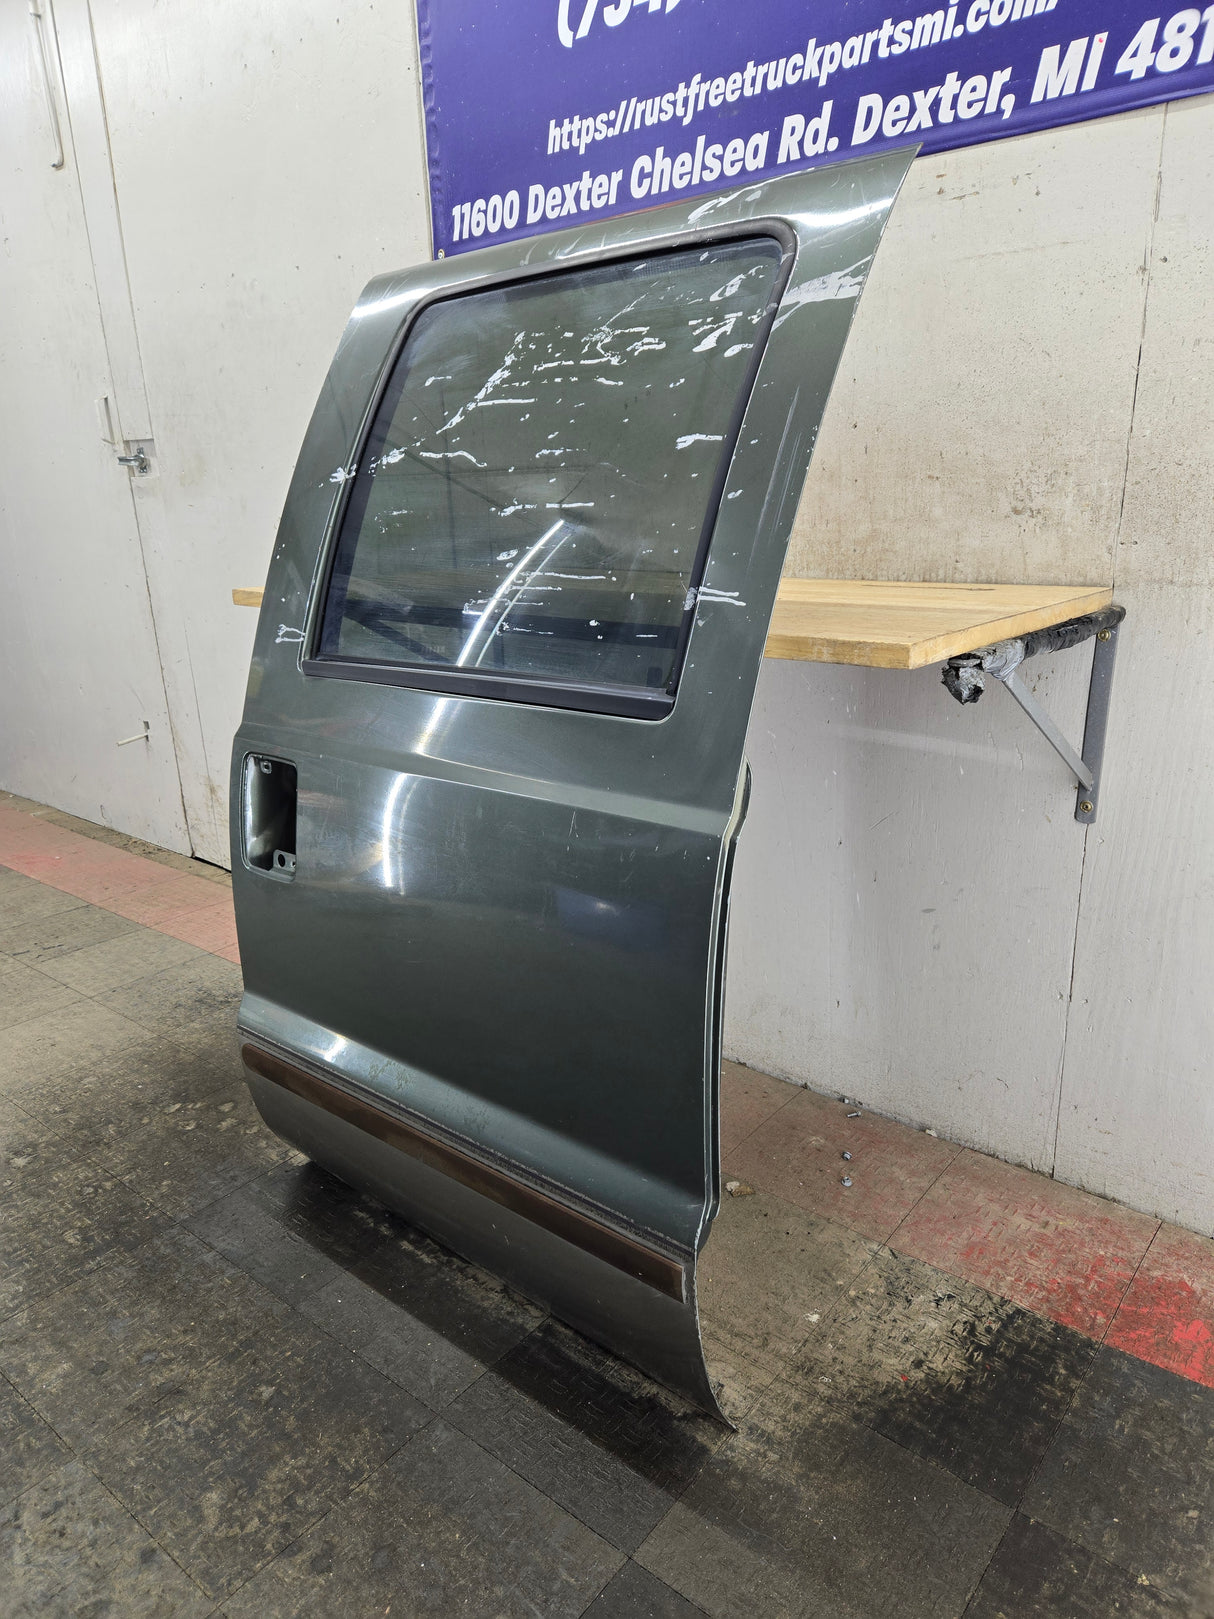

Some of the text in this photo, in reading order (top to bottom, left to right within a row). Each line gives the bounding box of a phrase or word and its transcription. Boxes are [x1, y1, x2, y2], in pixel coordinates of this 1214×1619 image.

[452, 4, 1214, 242] 11600 Dexter Chelsea Rd. Dexter, MI 481
[547, 0, 1058, 155] https://rustfreetruckpartsmi.com
